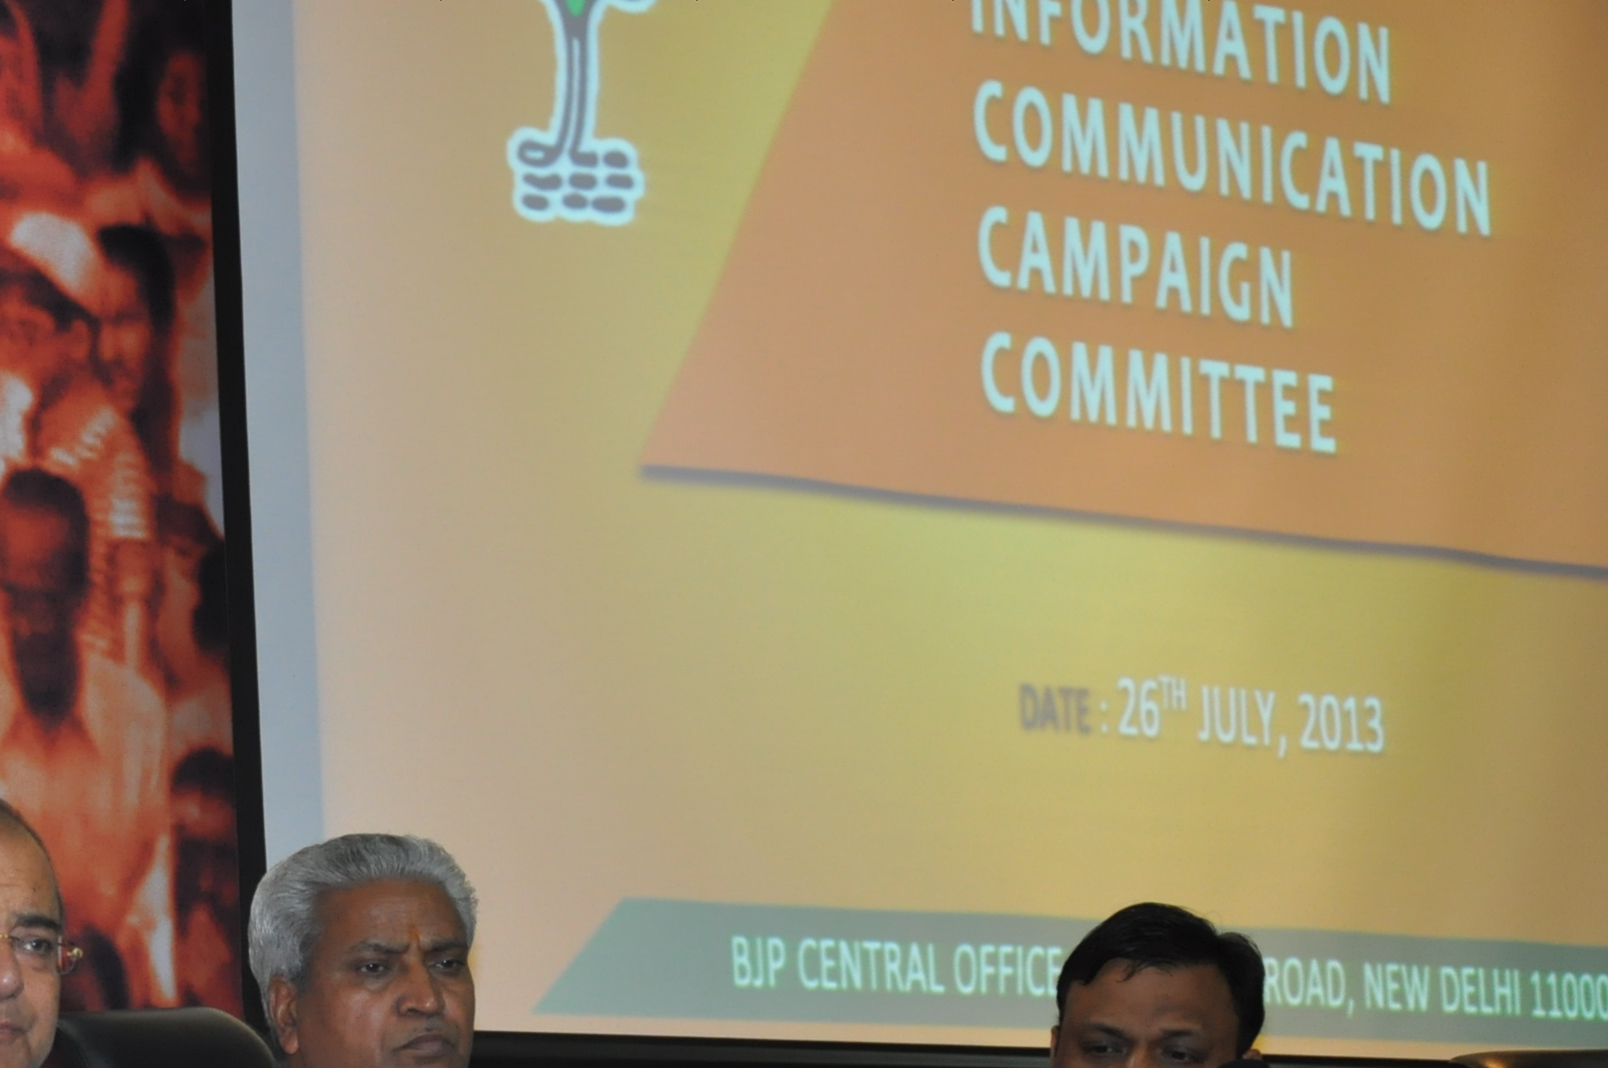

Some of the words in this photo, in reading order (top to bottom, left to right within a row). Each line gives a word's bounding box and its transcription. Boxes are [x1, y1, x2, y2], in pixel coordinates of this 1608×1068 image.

[974, 79, 1491, 236] COMMUNICATION
[978, 205, 1293, 328] CAMPAIGN
[981, 331, 1336, 453] COMMITTEE
[1019, 683, 1091, 735] DATE
[1197, 685, 1287, 758] JULY,
[1298, 693, 1385, 753] 2013
[731, 935, 786, 988] BJP
[797, 938, 945, 993] CENTRAL
[953, 943, 1063, 997] OFFICE
[1263, 957, 1353, 1018] ROAD,
[1363, 961, 1429, 1012] NEW
[1440, 965, 1521, 1016] DELHI
